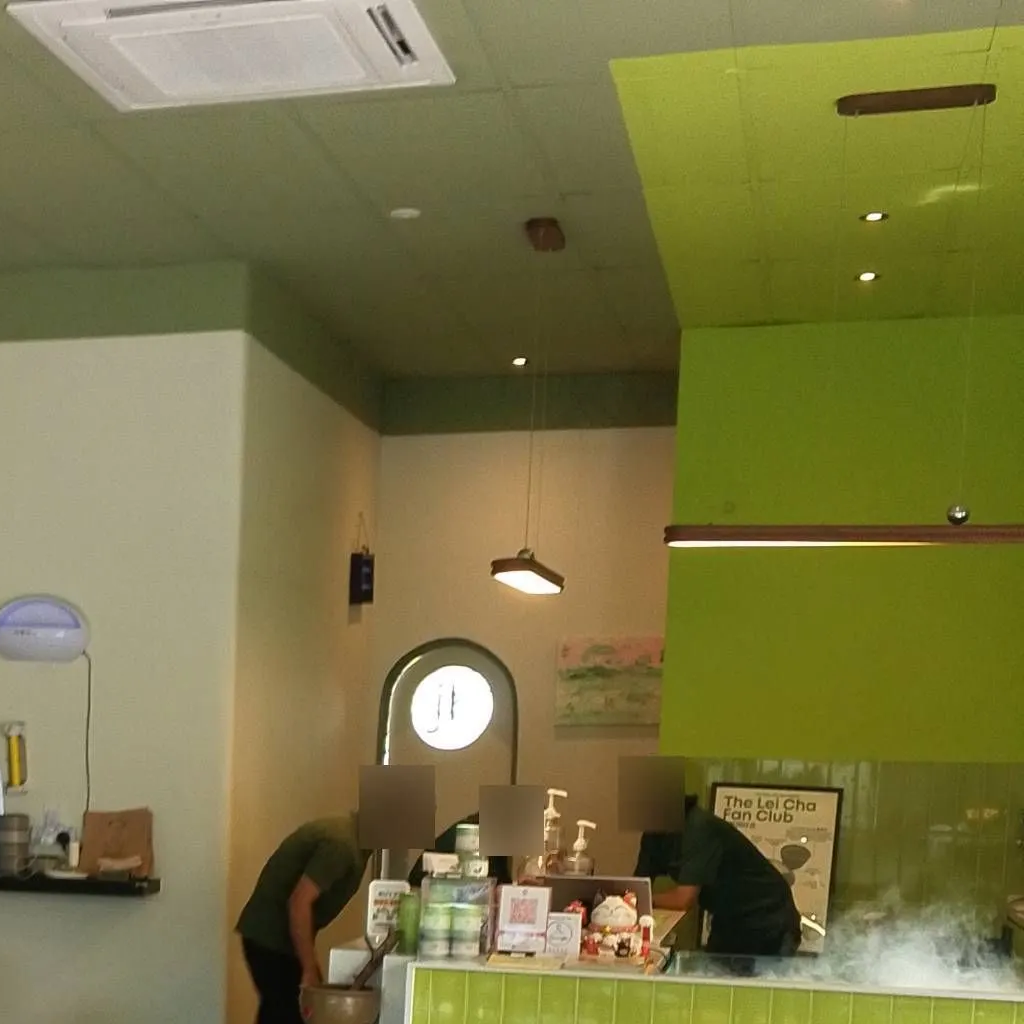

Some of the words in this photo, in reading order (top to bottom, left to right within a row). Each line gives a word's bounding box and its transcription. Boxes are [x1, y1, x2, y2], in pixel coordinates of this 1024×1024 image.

[724, 795, 753, 809] The
[783, 798, 816, 812] Cha
[723, 808, 752, 821] Fan
[756, 810, 793, 823] Club
